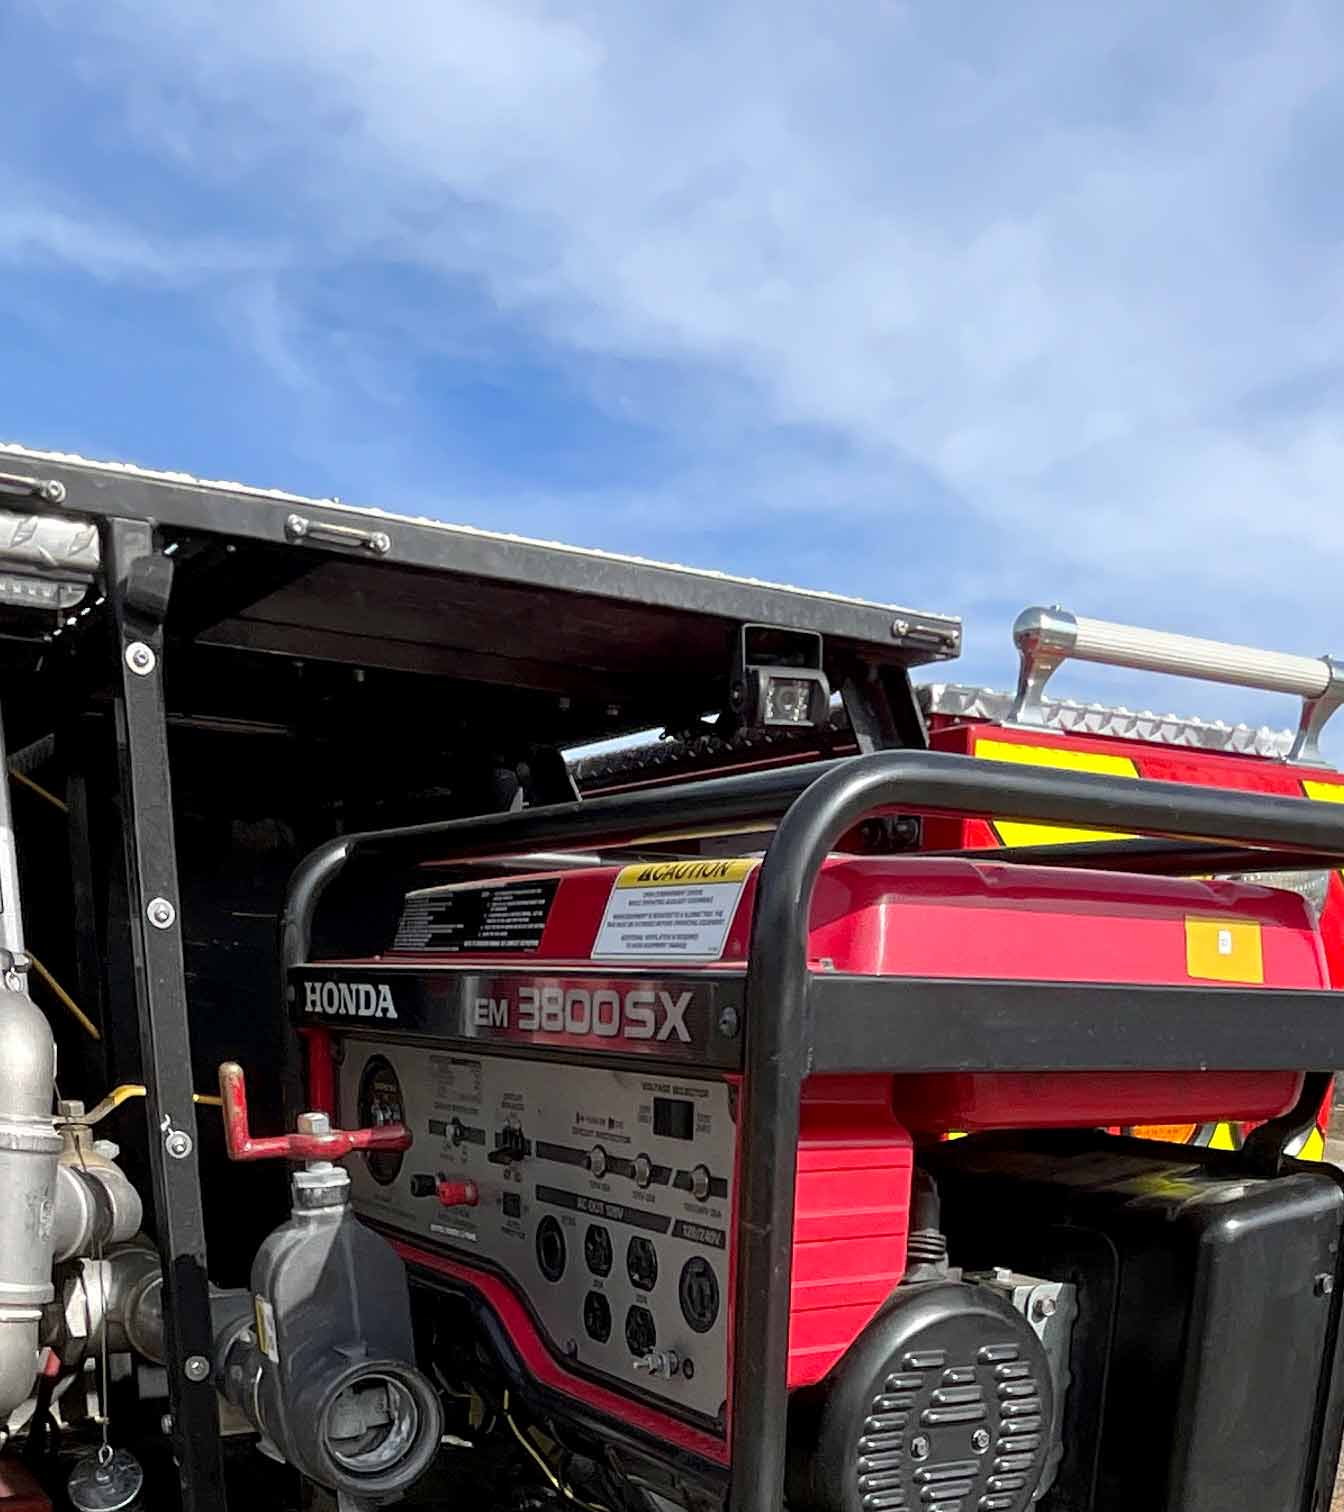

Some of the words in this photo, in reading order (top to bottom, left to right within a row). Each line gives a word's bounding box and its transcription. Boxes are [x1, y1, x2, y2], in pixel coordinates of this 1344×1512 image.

[652, 862, 731, 881] CAUTION
[303, 980, 398, 1020] HONDA
[475, 997, 508, 1028] EM
